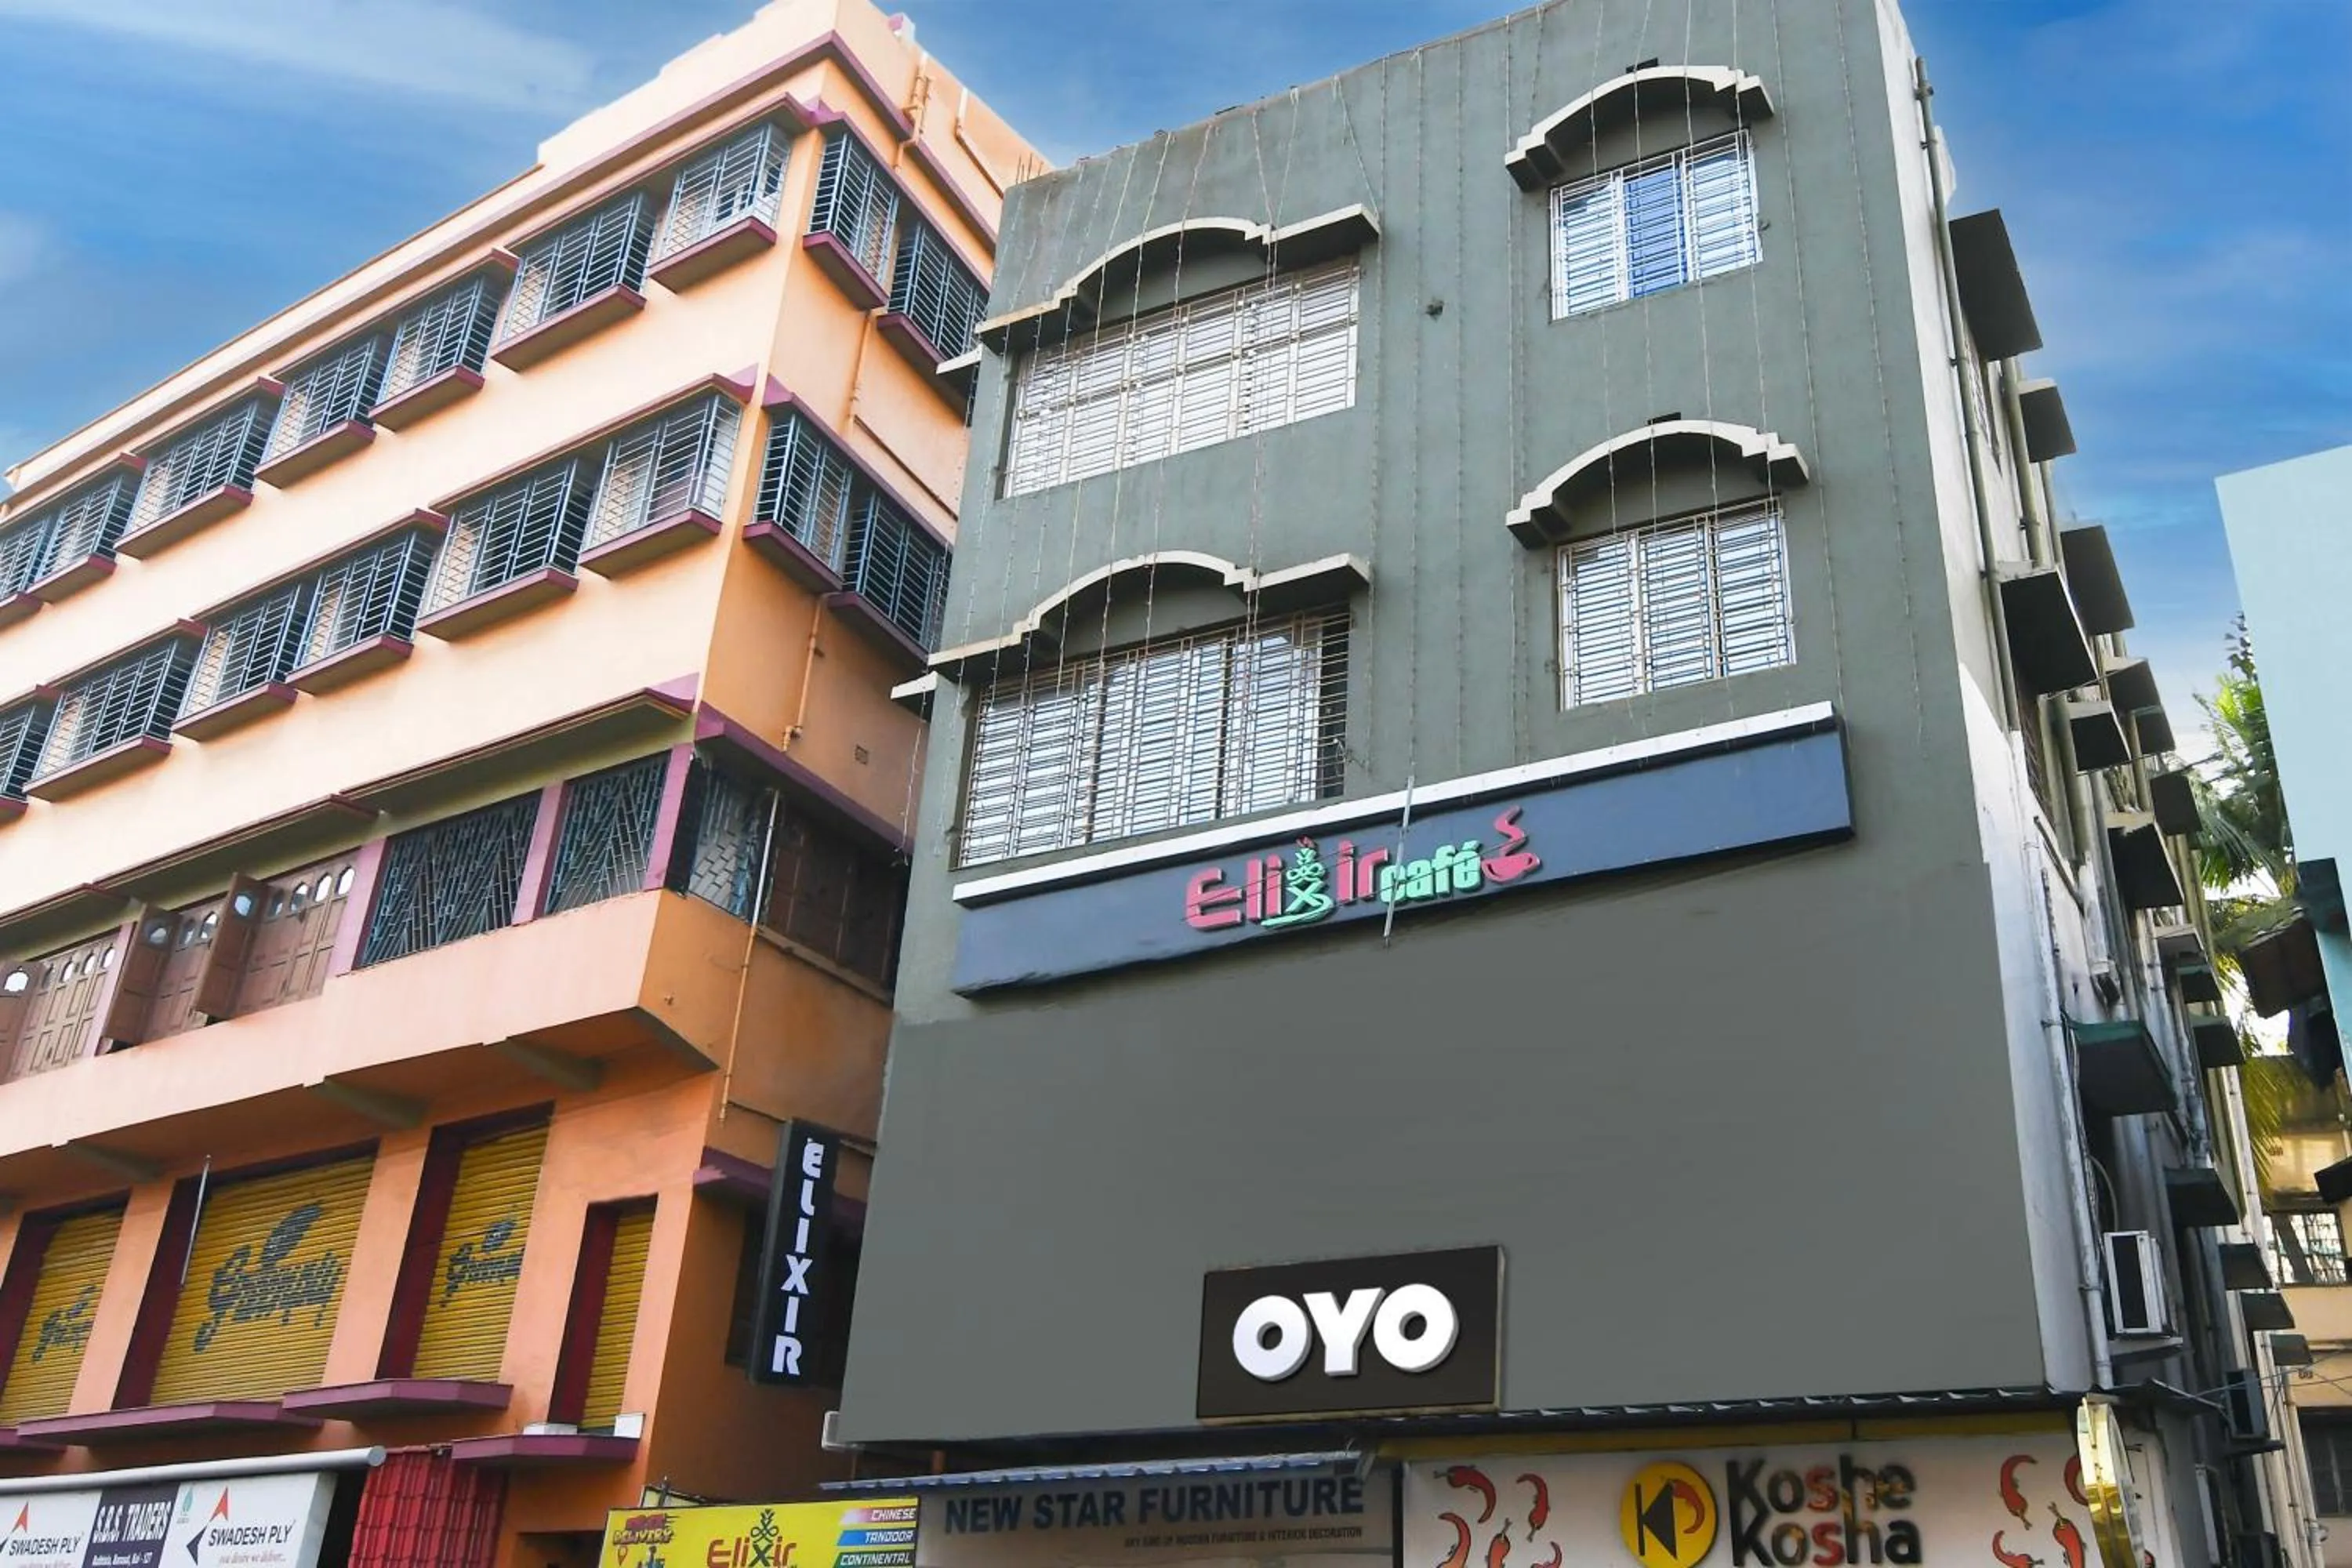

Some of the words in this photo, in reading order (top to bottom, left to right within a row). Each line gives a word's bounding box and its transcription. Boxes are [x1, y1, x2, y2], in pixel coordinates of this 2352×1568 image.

[1185, 837, 1389, 929] Elixir
[771, 1138, 825, 1376] ELIXIR
[1232, 1283, 1459, 1381] OYO
[1726, 1454, 1915, 1515] Koshe
[872, 1508, 916, 1520] CHINESE
[946, 1497, 1022, 1534] NEW
[1033, 1490, 1127, 1530] STAR
[1138, 1477, 1364, 1524] FURNITURE
[9, 1537, 59, 1555] SWADESH
[59, 1536, 81, 1553] PLY
[209, 1527, 267, 1547] SWADESH
[267, 1523, 295, 1543] PLY
[706, 1537, 797, 1567] Elixir
[865, 1531, 913, 1542] TANDOOR
[1731, 1518, 1922, 1567] Kosha
[840, 1554, 910, 1566] CONTINENTAL
